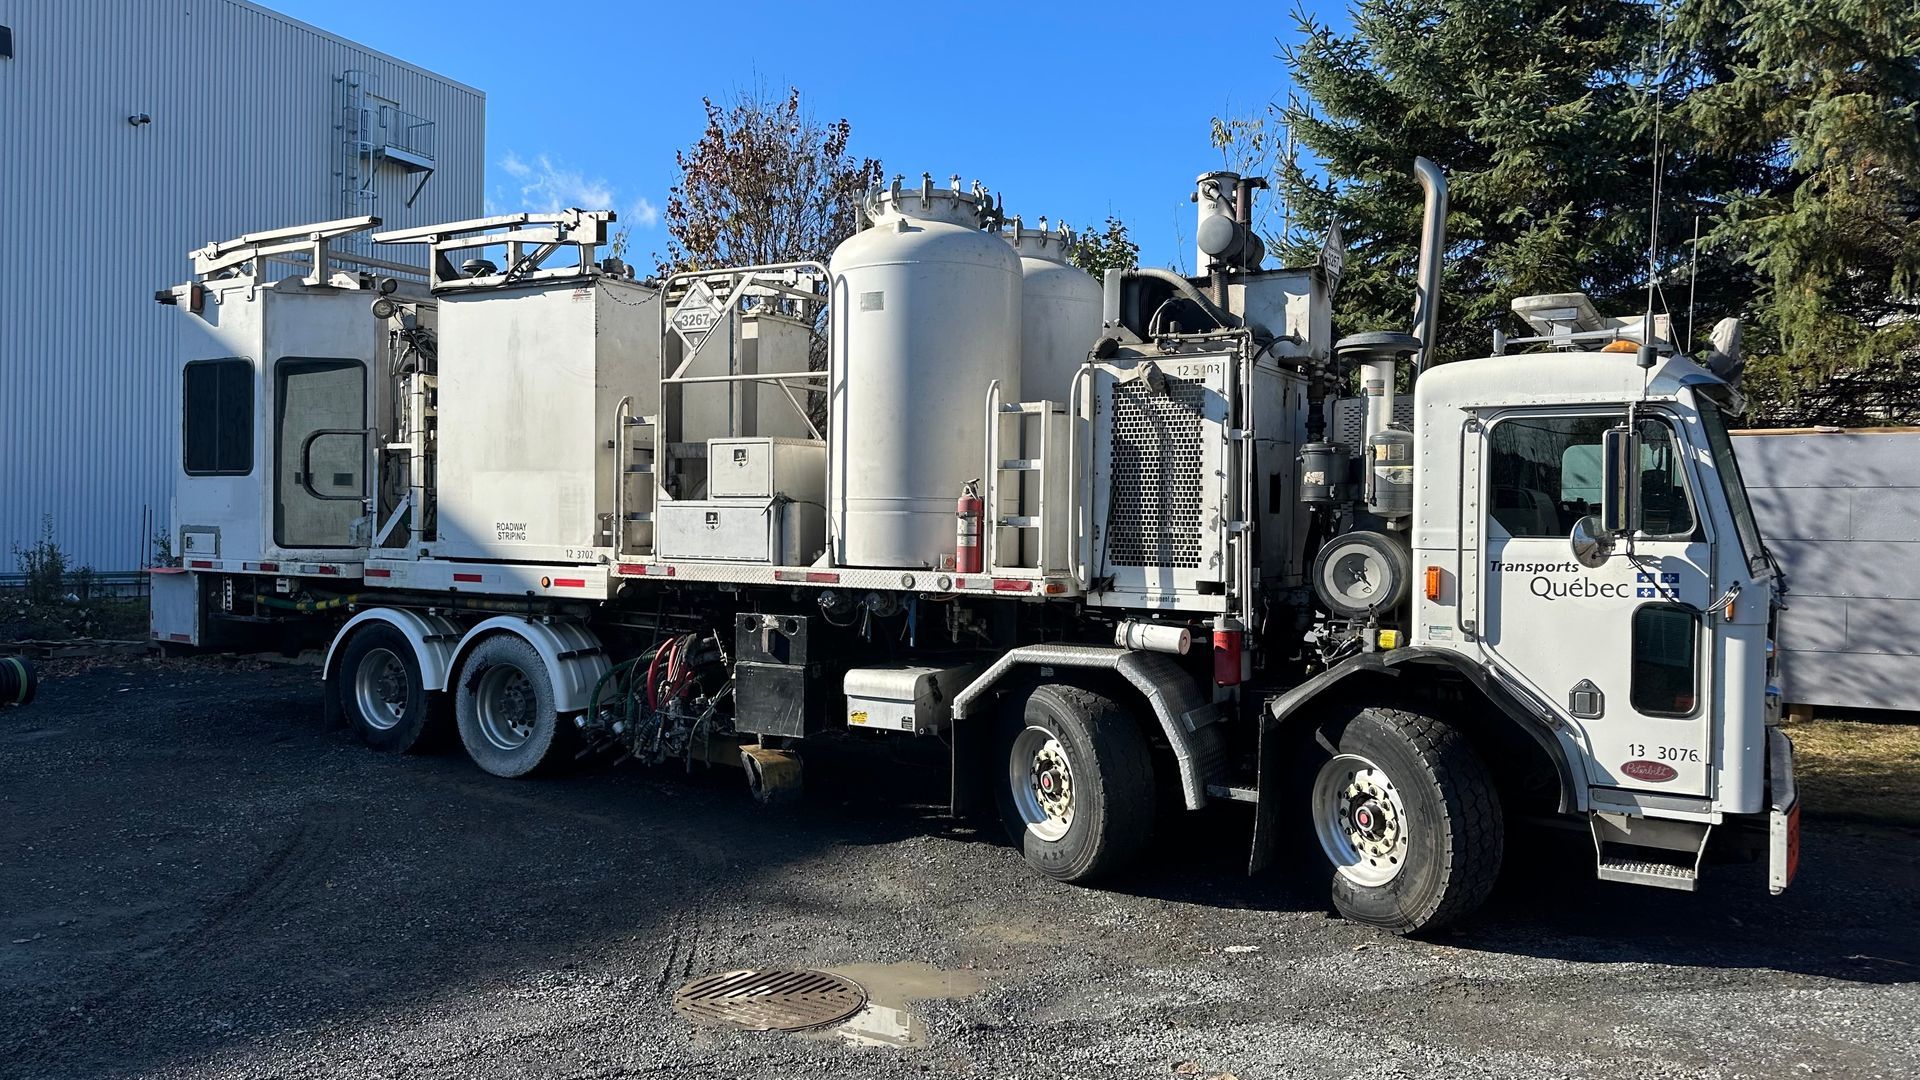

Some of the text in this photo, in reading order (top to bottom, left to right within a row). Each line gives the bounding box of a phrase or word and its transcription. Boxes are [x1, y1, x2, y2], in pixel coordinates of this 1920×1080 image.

[682, 313, 709, 327] 3267
[693, 337, 699, 346] 8
[1177, 365, 1189, 376] 12
[496, 522, 527, 532] ROADWAY
[497, 531, 526, 541] STRIPING
[566, 549, 594, 559] 12 3702
[1490, 560, 1580, 575] Transports
[1529, 576, 1630, 601] Québec
[1628, 743, 1700, 763] 13 3076
[1626, 762, 1670, 776] Peterbilt
